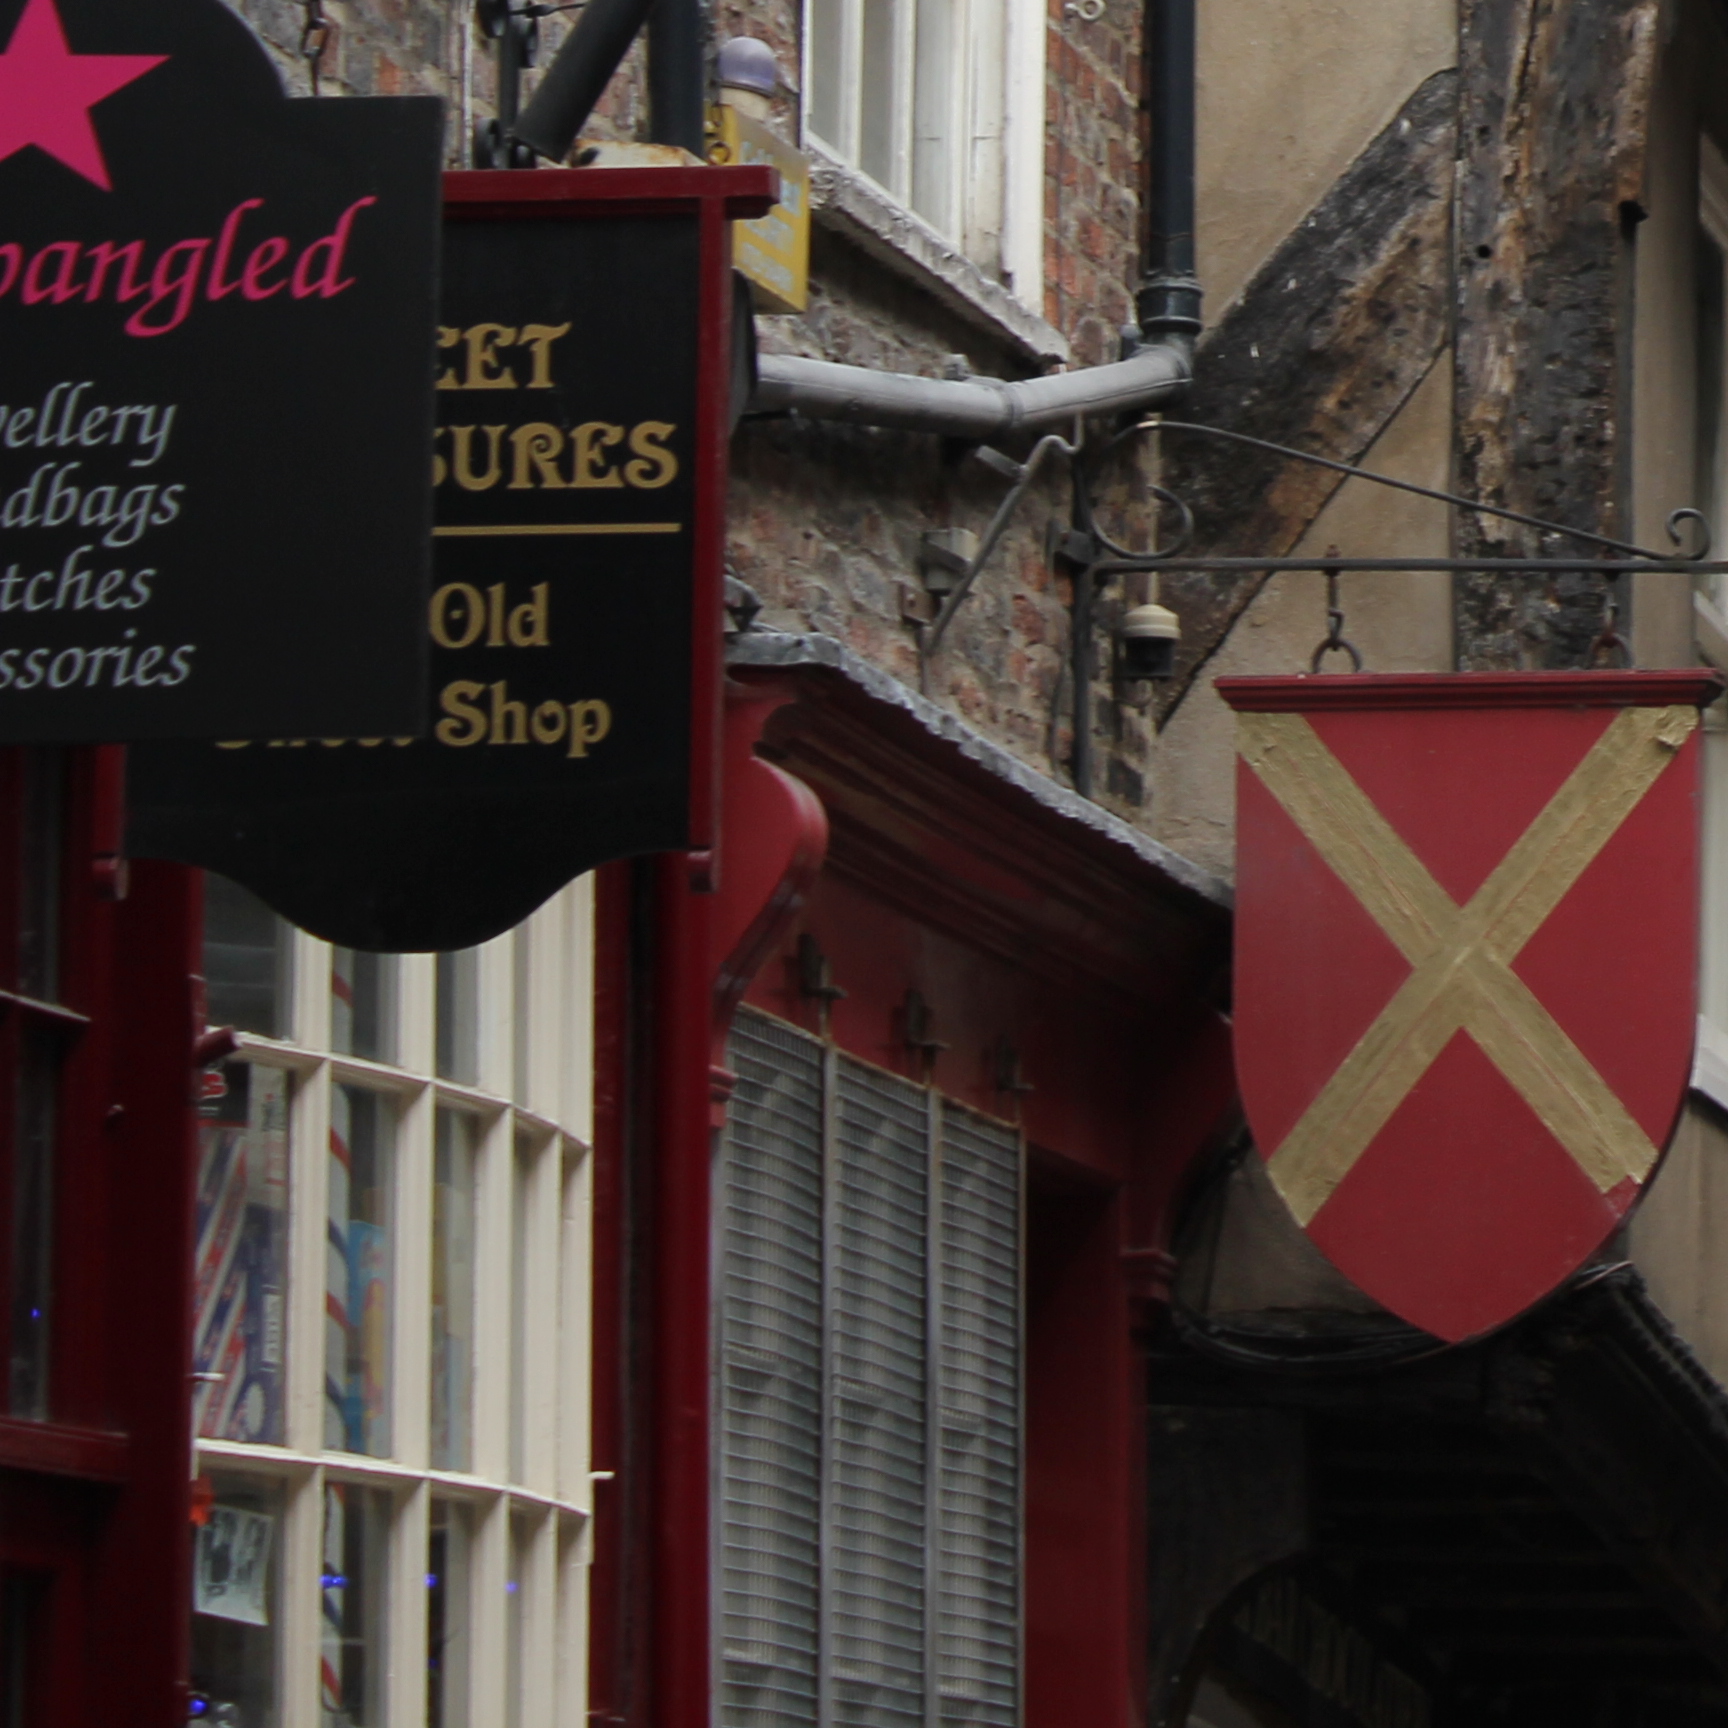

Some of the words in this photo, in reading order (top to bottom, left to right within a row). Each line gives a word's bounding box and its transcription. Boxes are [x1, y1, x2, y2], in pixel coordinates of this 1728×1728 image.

[0, 380, 178, 468] ellery
[432, 420, 679, 492] URES
[428, 581, 550, 649] Old
[435, 679, 613, 759] Shop
